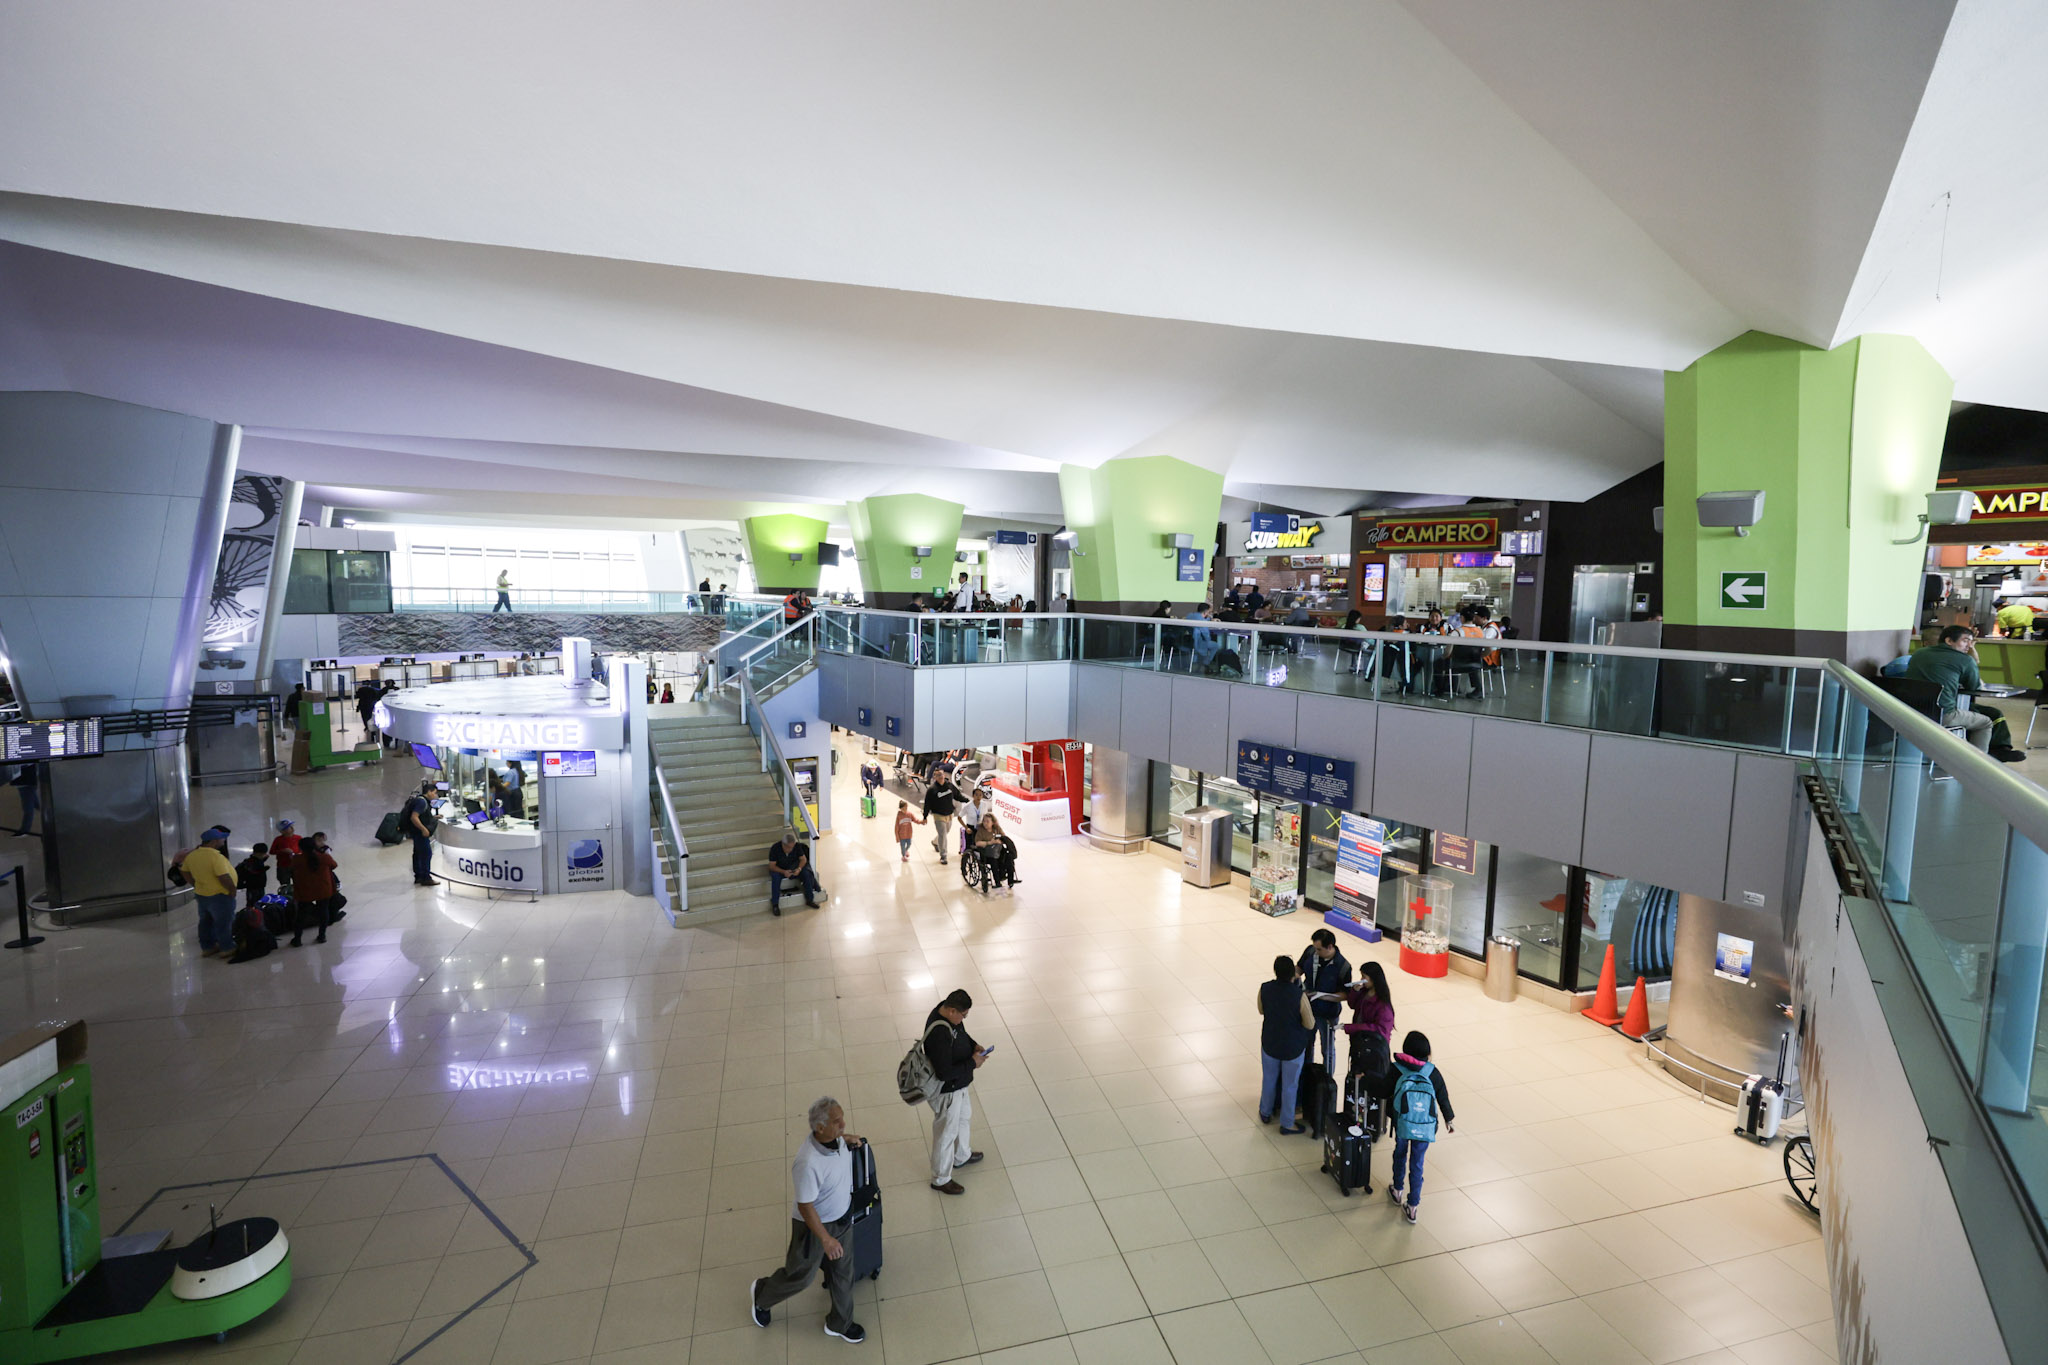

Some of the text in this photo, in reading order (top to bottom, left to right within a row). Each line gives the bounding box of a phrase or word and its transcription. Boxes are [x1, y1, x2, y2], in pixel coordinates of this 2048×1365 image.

[1245, 524, 1320, 551] SUBWAY
[1366, 526, 1389, 544] Pollo
[1391, 522, 1490, 543] CAMPERO
[433, 721, 579, 745] EXCHANGE
[995, 799, 1021, 814] ASSIST
[1002, 810, 1022, 825] CARD
[458, 857, 524, 882] cambio
[568, 868, 604, 876] global
